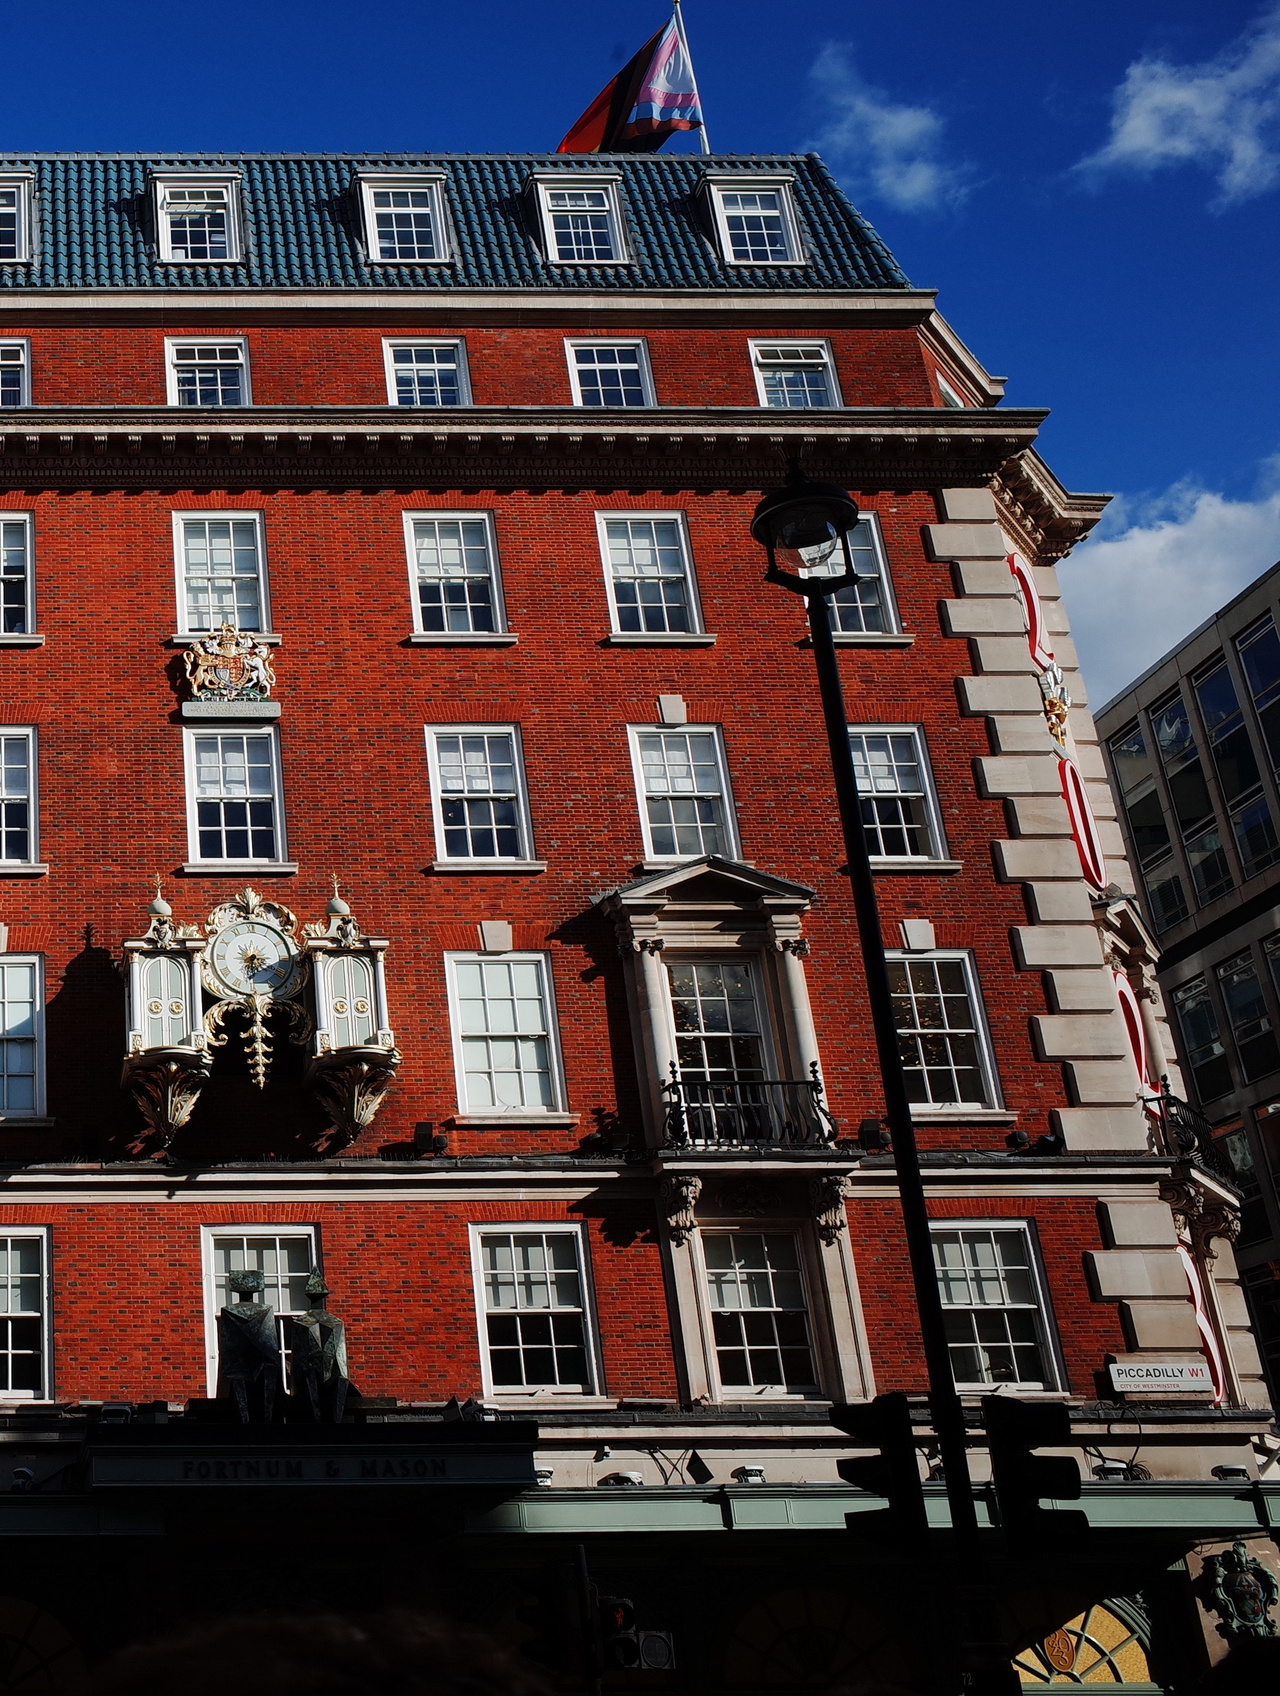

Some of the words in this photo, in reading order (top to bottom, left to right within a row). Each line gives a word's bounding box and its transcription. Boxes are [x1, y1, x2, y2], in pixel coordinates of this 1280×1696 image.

[1116, 1368, 1184, 1378] PICCADILLY
[1187, 1368, 1205, 1378] W1
[183, 1460, 303, 1479] FORTNUM
[326, 1460, 339, 1478] &
[360, 1459, 447, 1478] MASON
